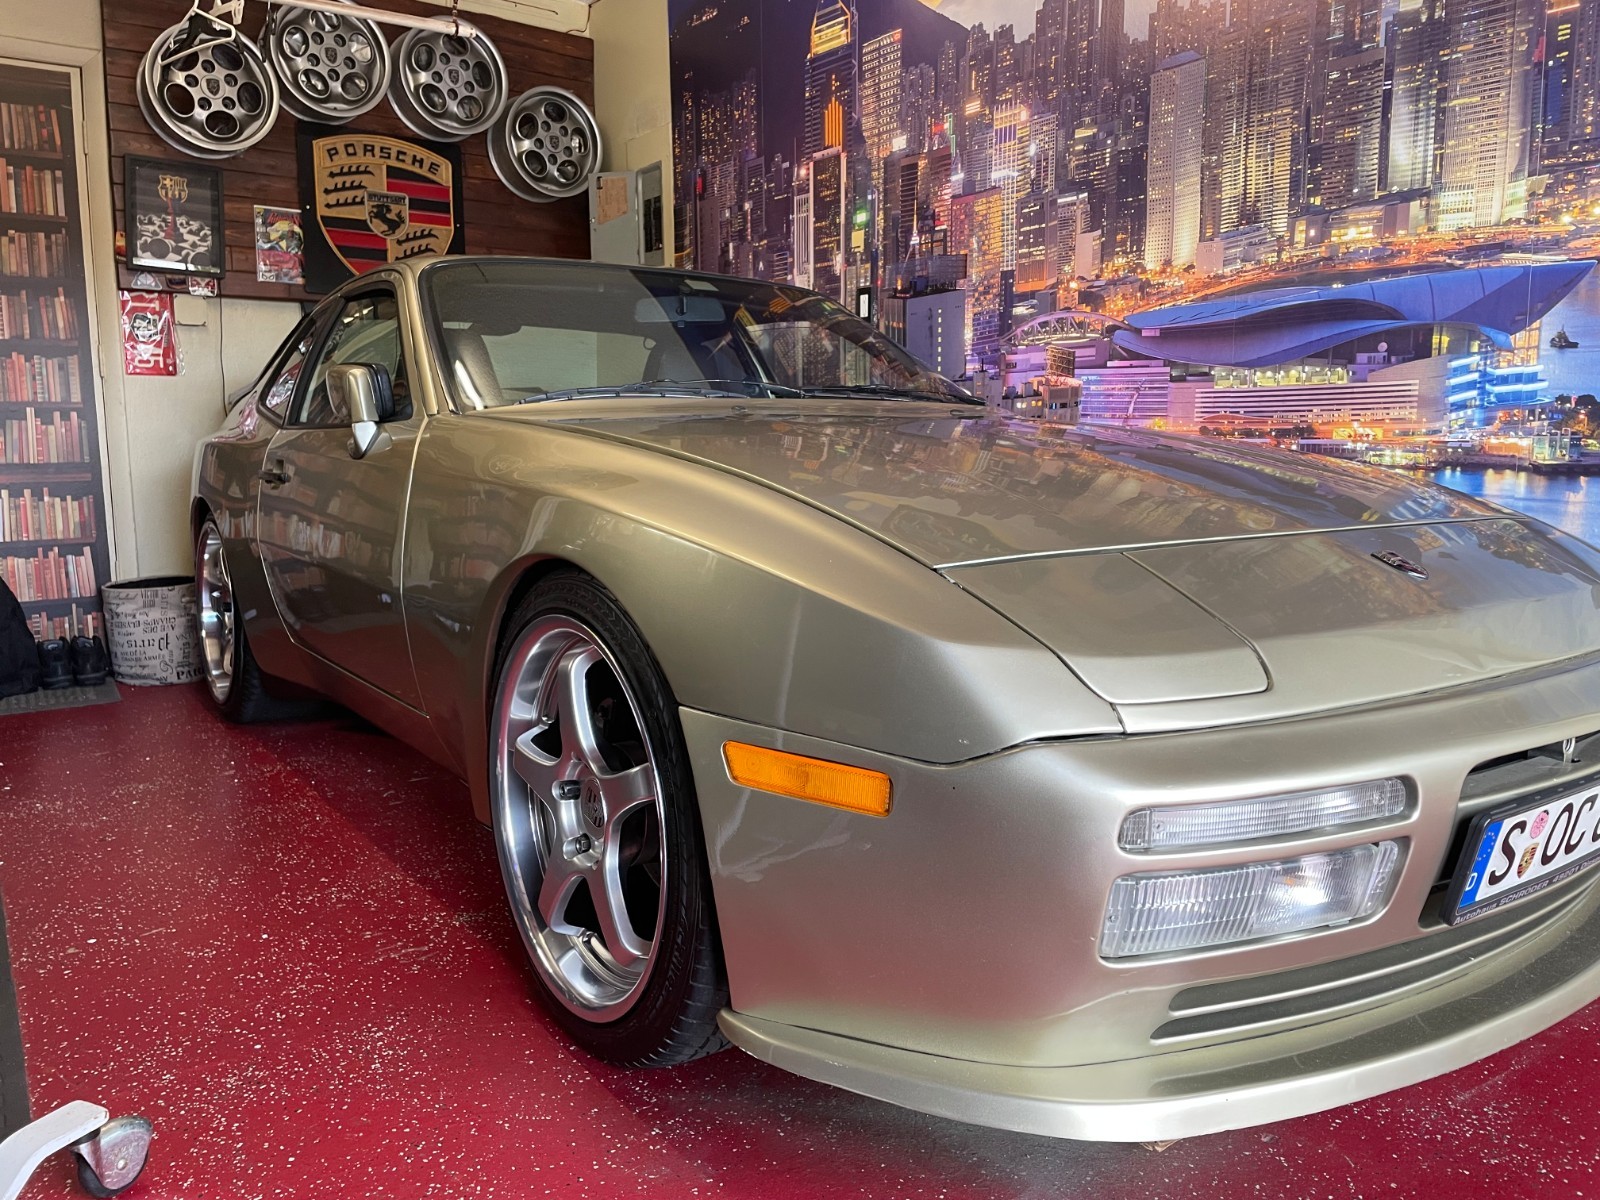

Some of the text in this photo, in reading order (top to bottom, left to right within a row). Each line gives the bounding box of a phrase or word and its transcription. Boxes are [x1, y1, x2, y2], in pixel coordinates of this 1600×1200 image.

[326, 143, 441, 176] PORSCHE
[127, 632, 171, 651] Paris
[1465, 872, 1478, 891] D
[1488, 819, 1528, 886] S
[1453, 903, 1498, 926] Autohaus
